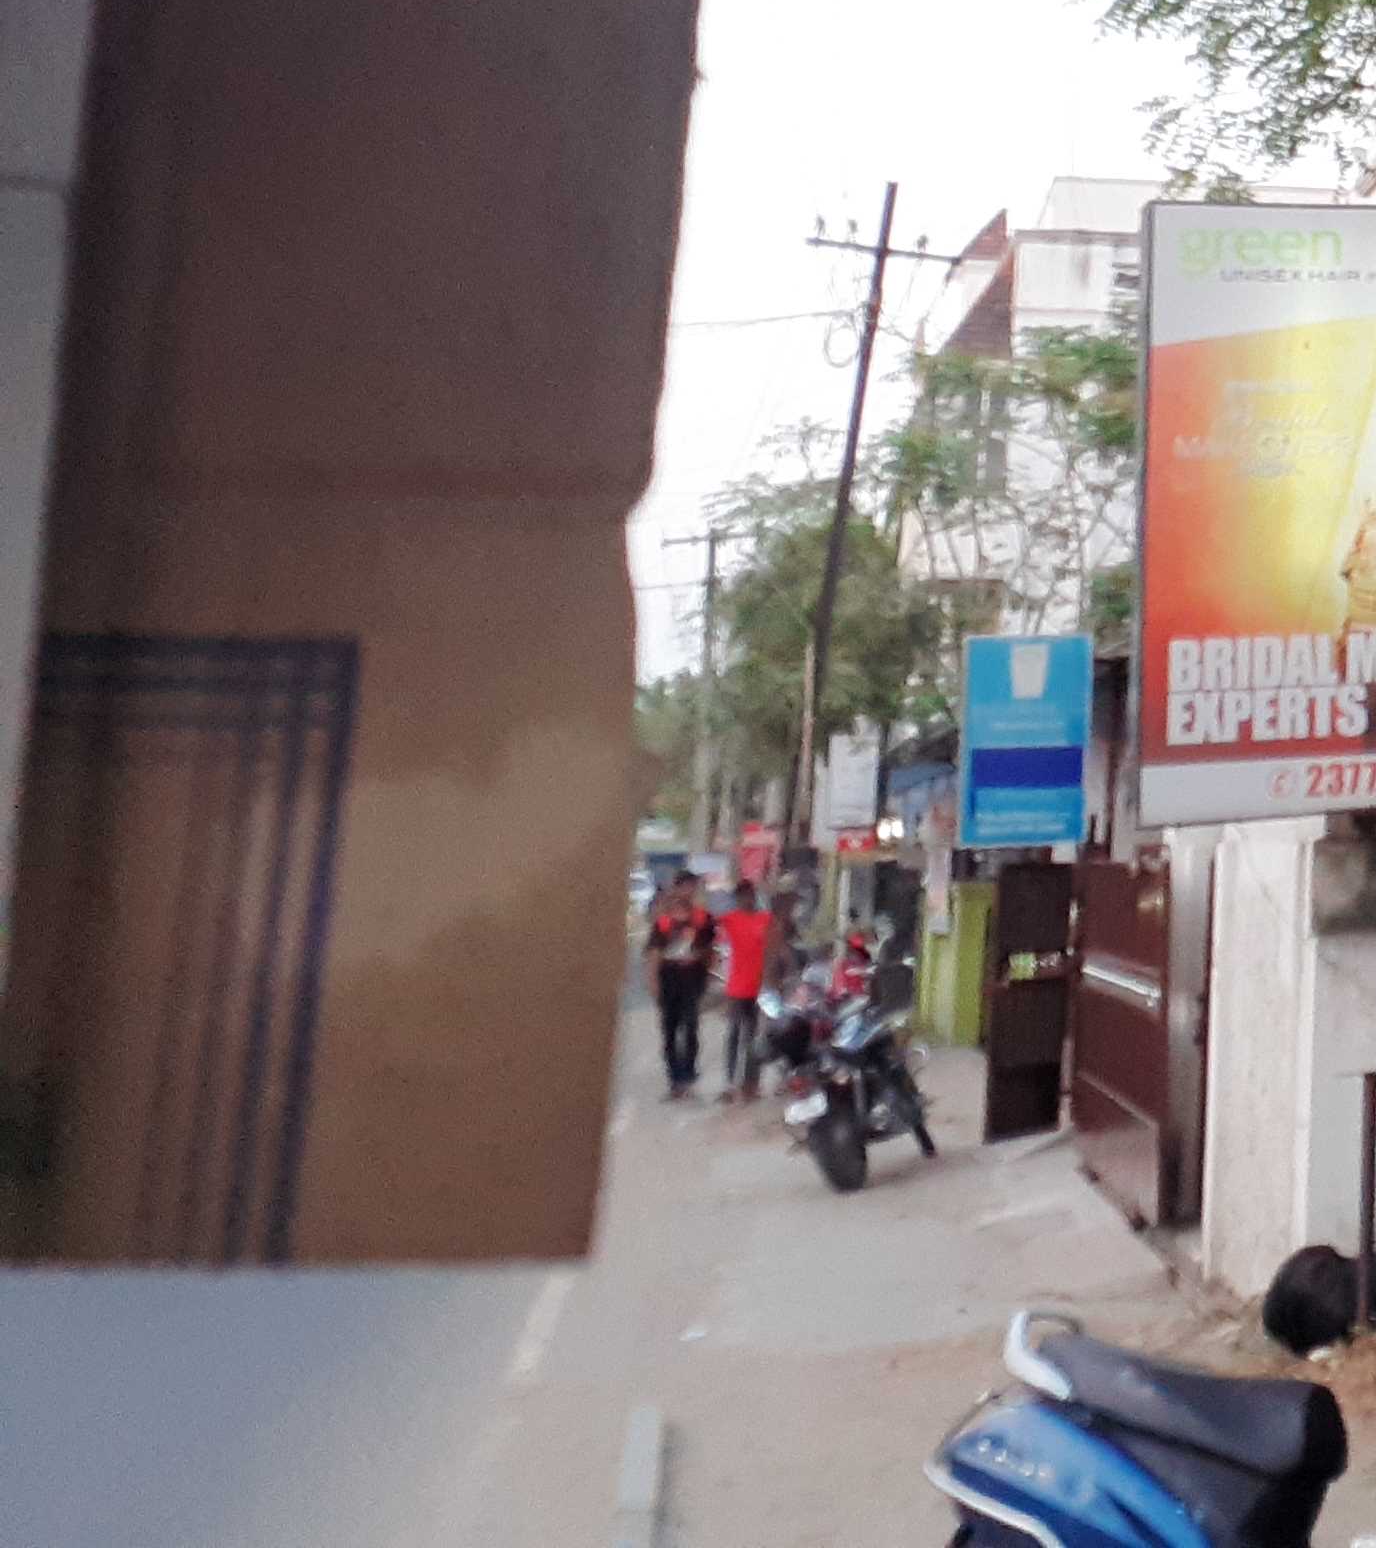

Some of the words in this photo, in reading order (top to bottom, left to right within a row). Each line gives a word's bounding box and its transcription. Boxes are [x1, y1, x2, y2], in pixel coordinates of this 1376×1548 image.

[1178, 227, 1344, 276] green
[1306, 268, 1361, 283] HAIR
[1167, 633, 1338, 691] BRIDAL
[1165, 684, 1370, 747] EXPERTS
